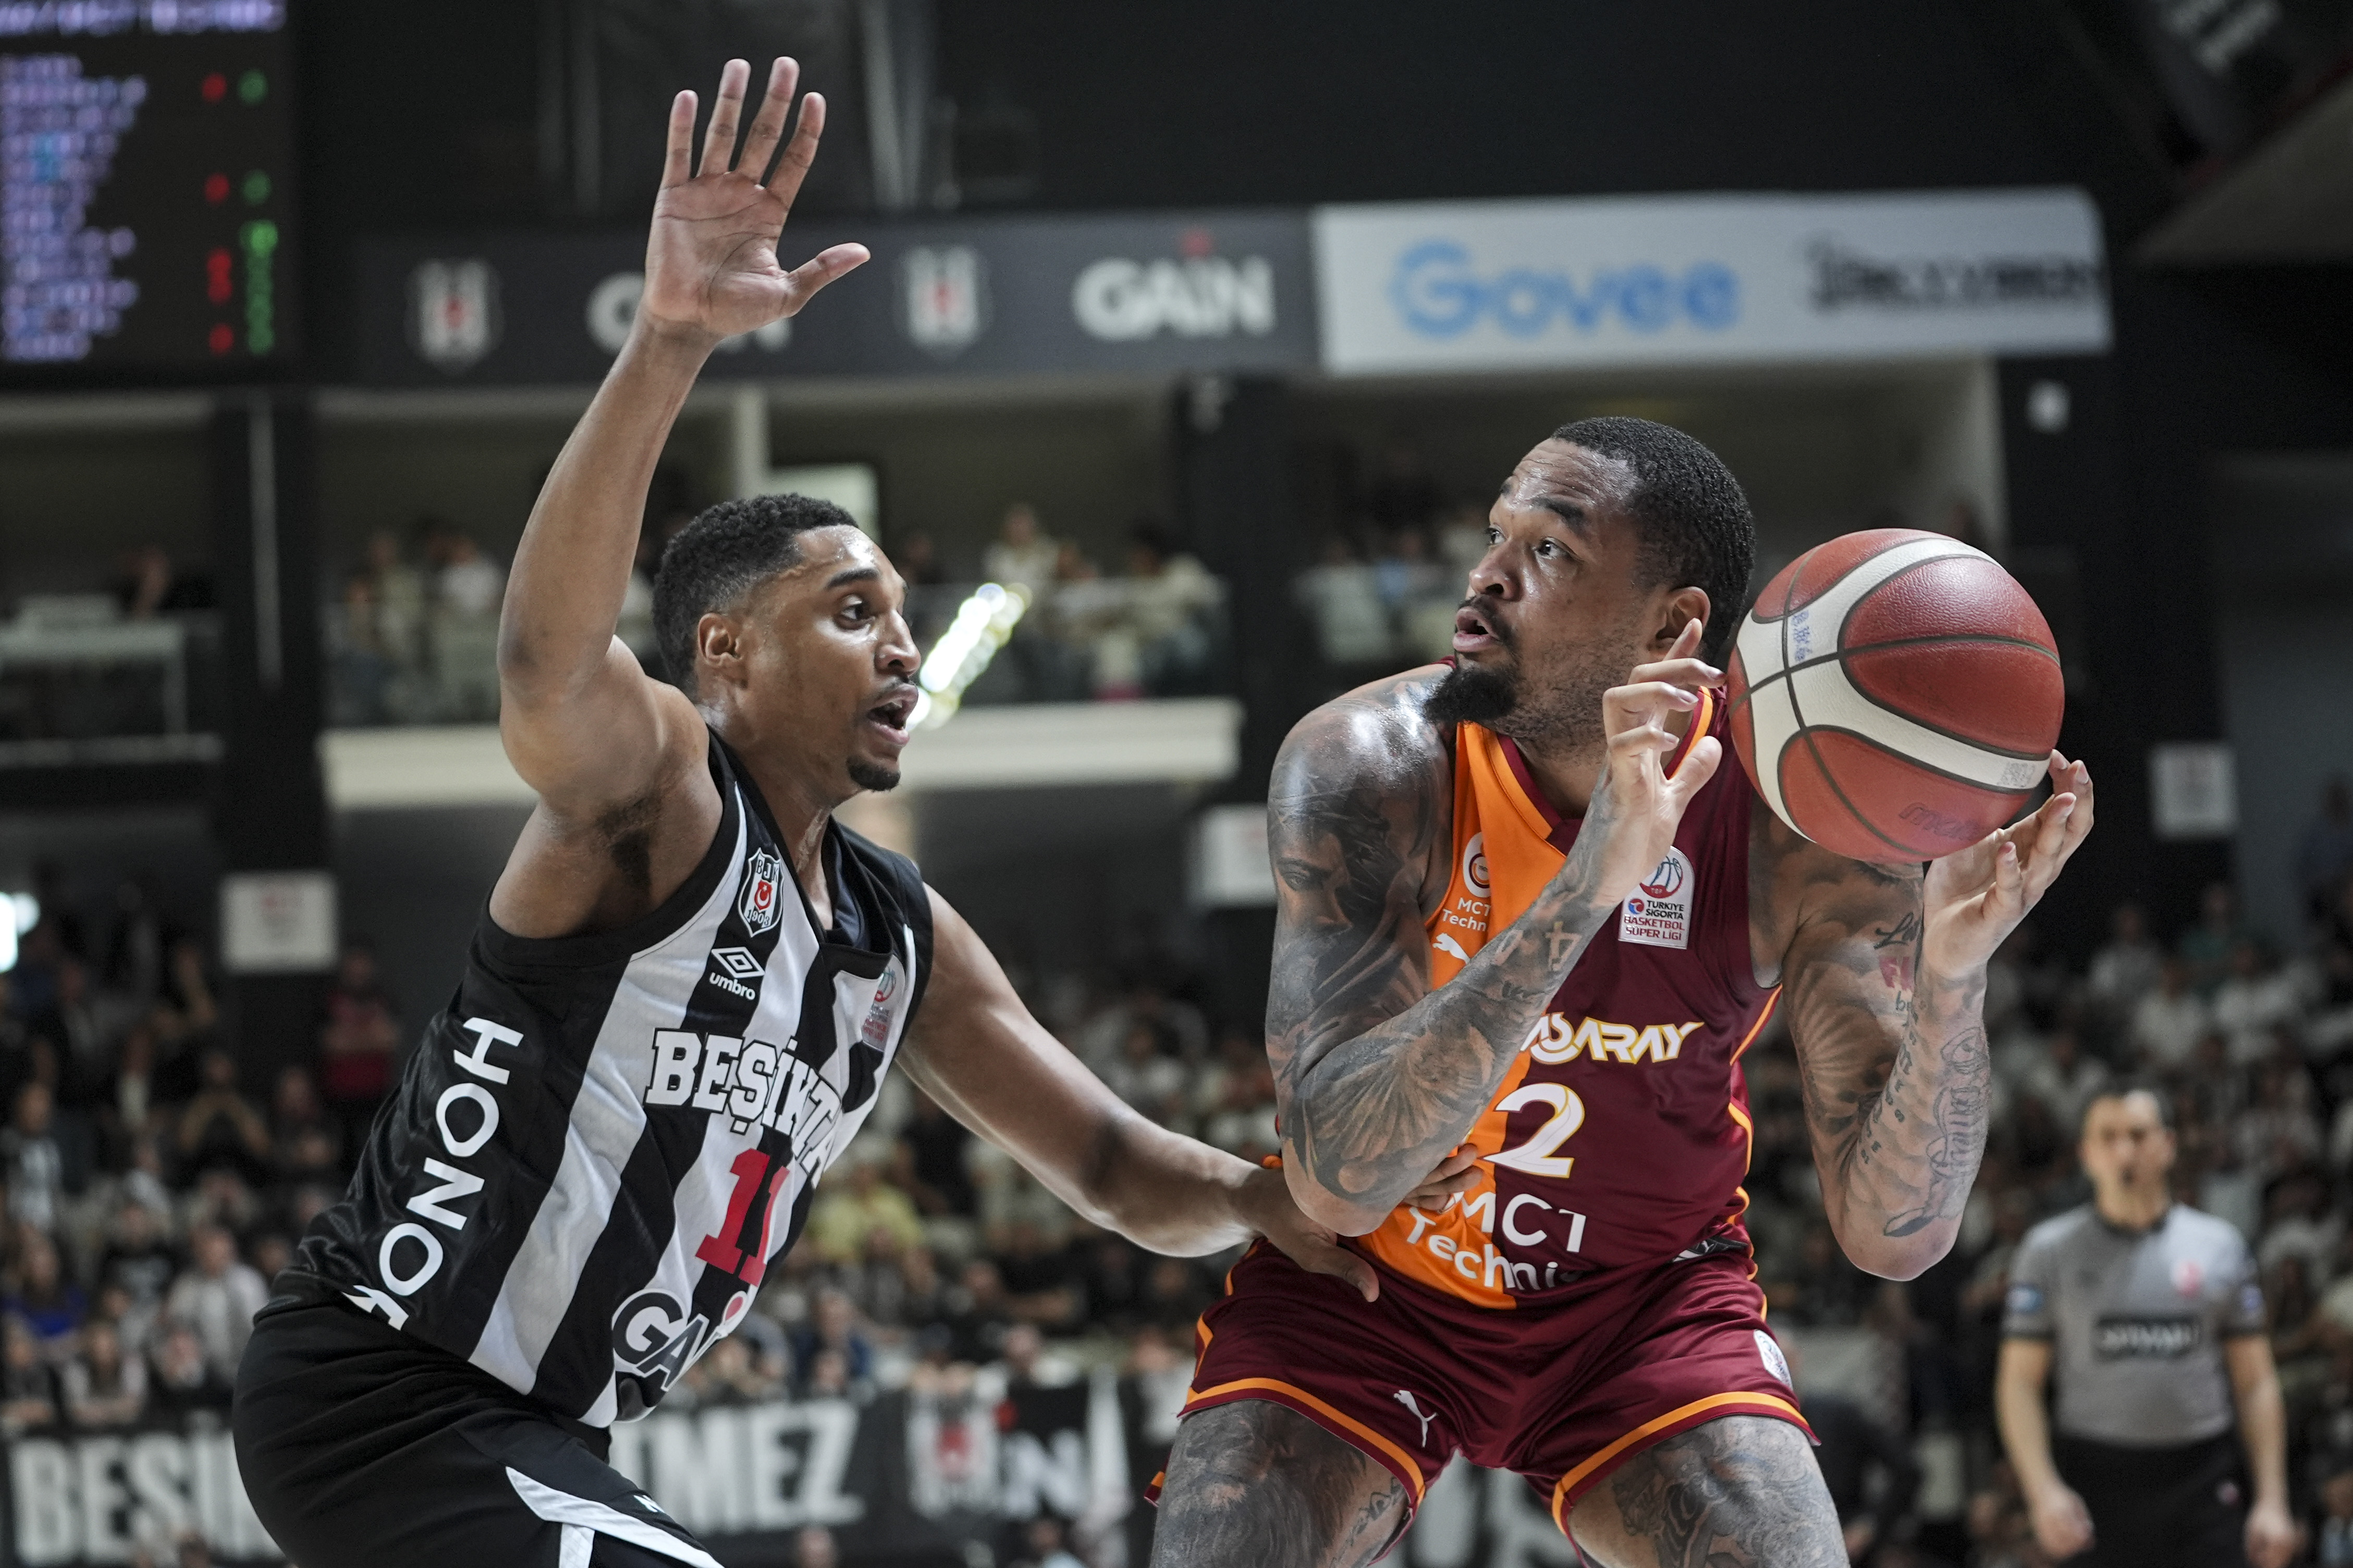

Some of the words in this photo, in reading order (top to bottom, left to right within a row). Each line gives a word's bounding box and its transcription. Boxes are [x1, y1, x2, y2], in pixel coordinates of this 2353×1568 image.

[1389, 238, 1740, 340] Govee
[756, 859, 779, 883] BJK
[747, 909, 770, 927] 1903
[1457, 897, 1491, 917] MCT
[1624, 915, 1685, 931] BASKETBOL
[709, 972, 756, 1001] umbro
[1463, 1082, 1585, 1179] 2
[1443, 1191, 1587, 1253] MCT
